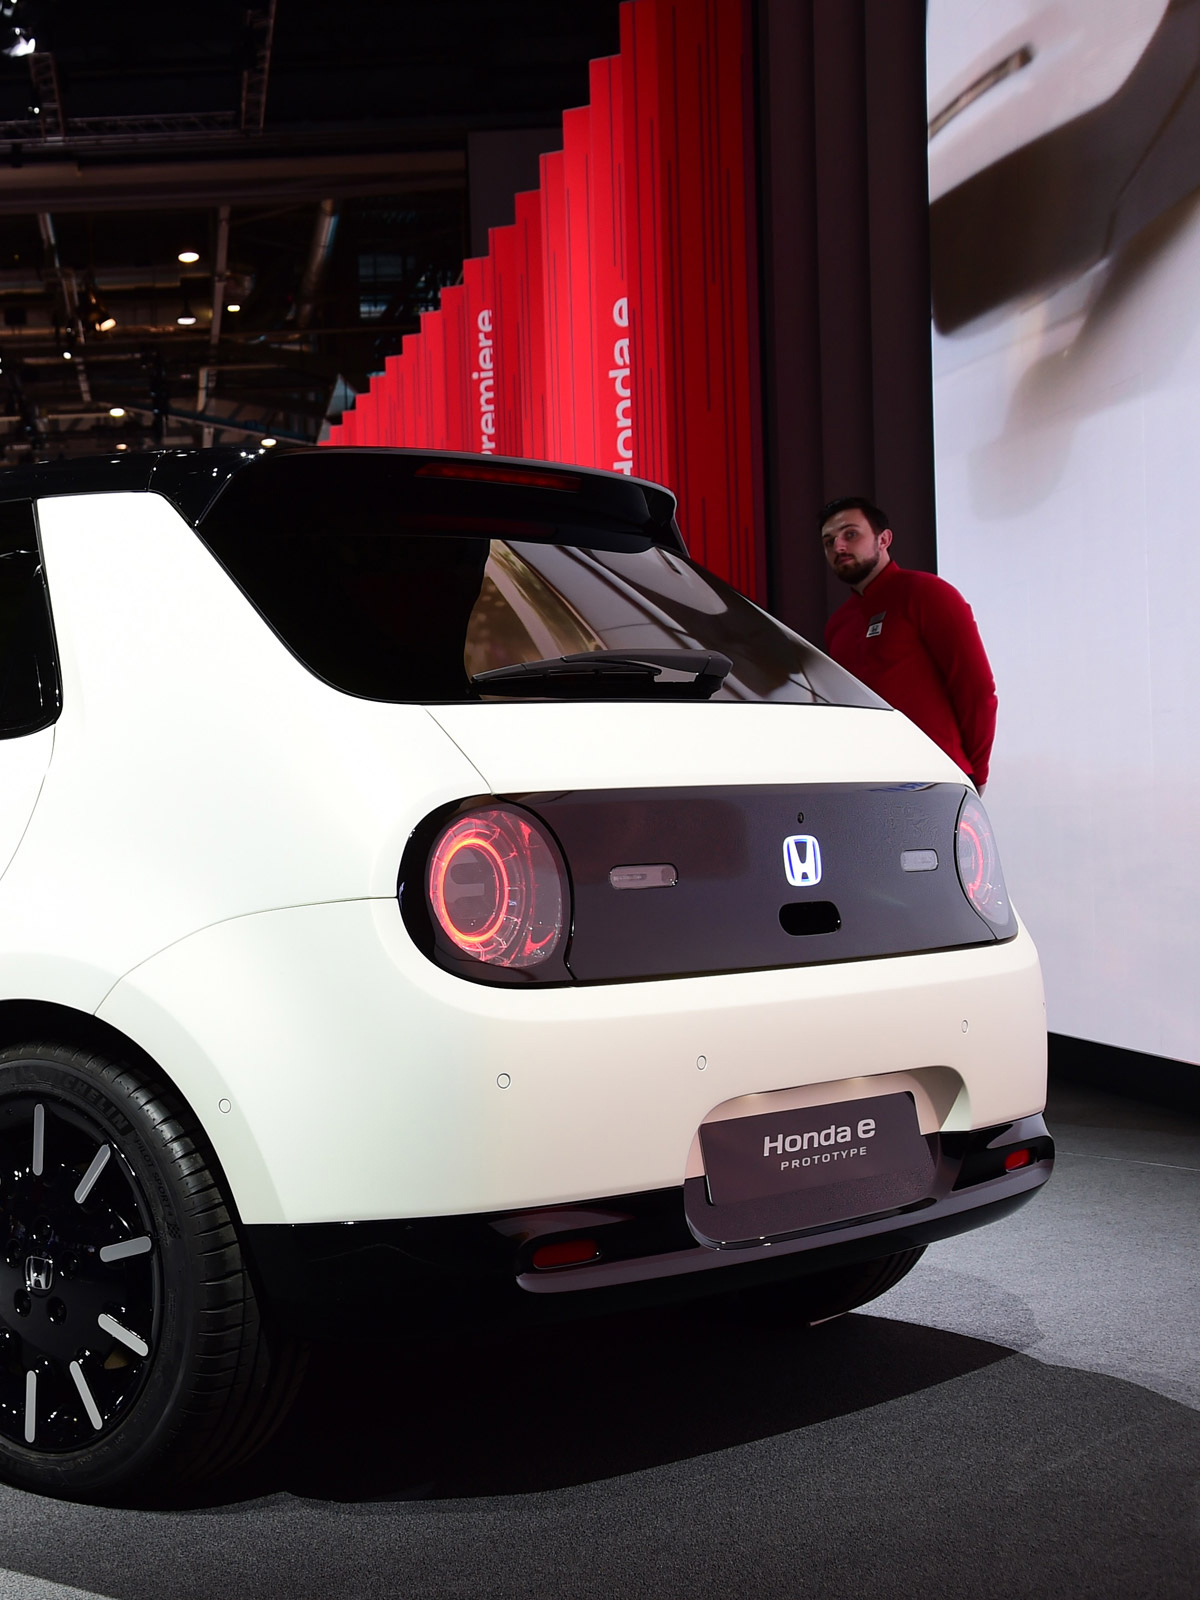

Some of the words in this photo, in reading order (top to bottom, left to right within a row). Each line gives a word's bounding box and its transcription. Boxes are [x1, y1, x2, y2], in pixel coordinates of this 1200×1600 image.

[471, 309, 496, 455] remiere
[43, 1068, 129, 1130] ICHELIN
[763, 1125, 852, 1157] Honda
[857, 1118, 876, 1139] e
[781, 1146, 867, 1171] PROTOTYPE
[153, 1172, 171, 1208] SPORT
